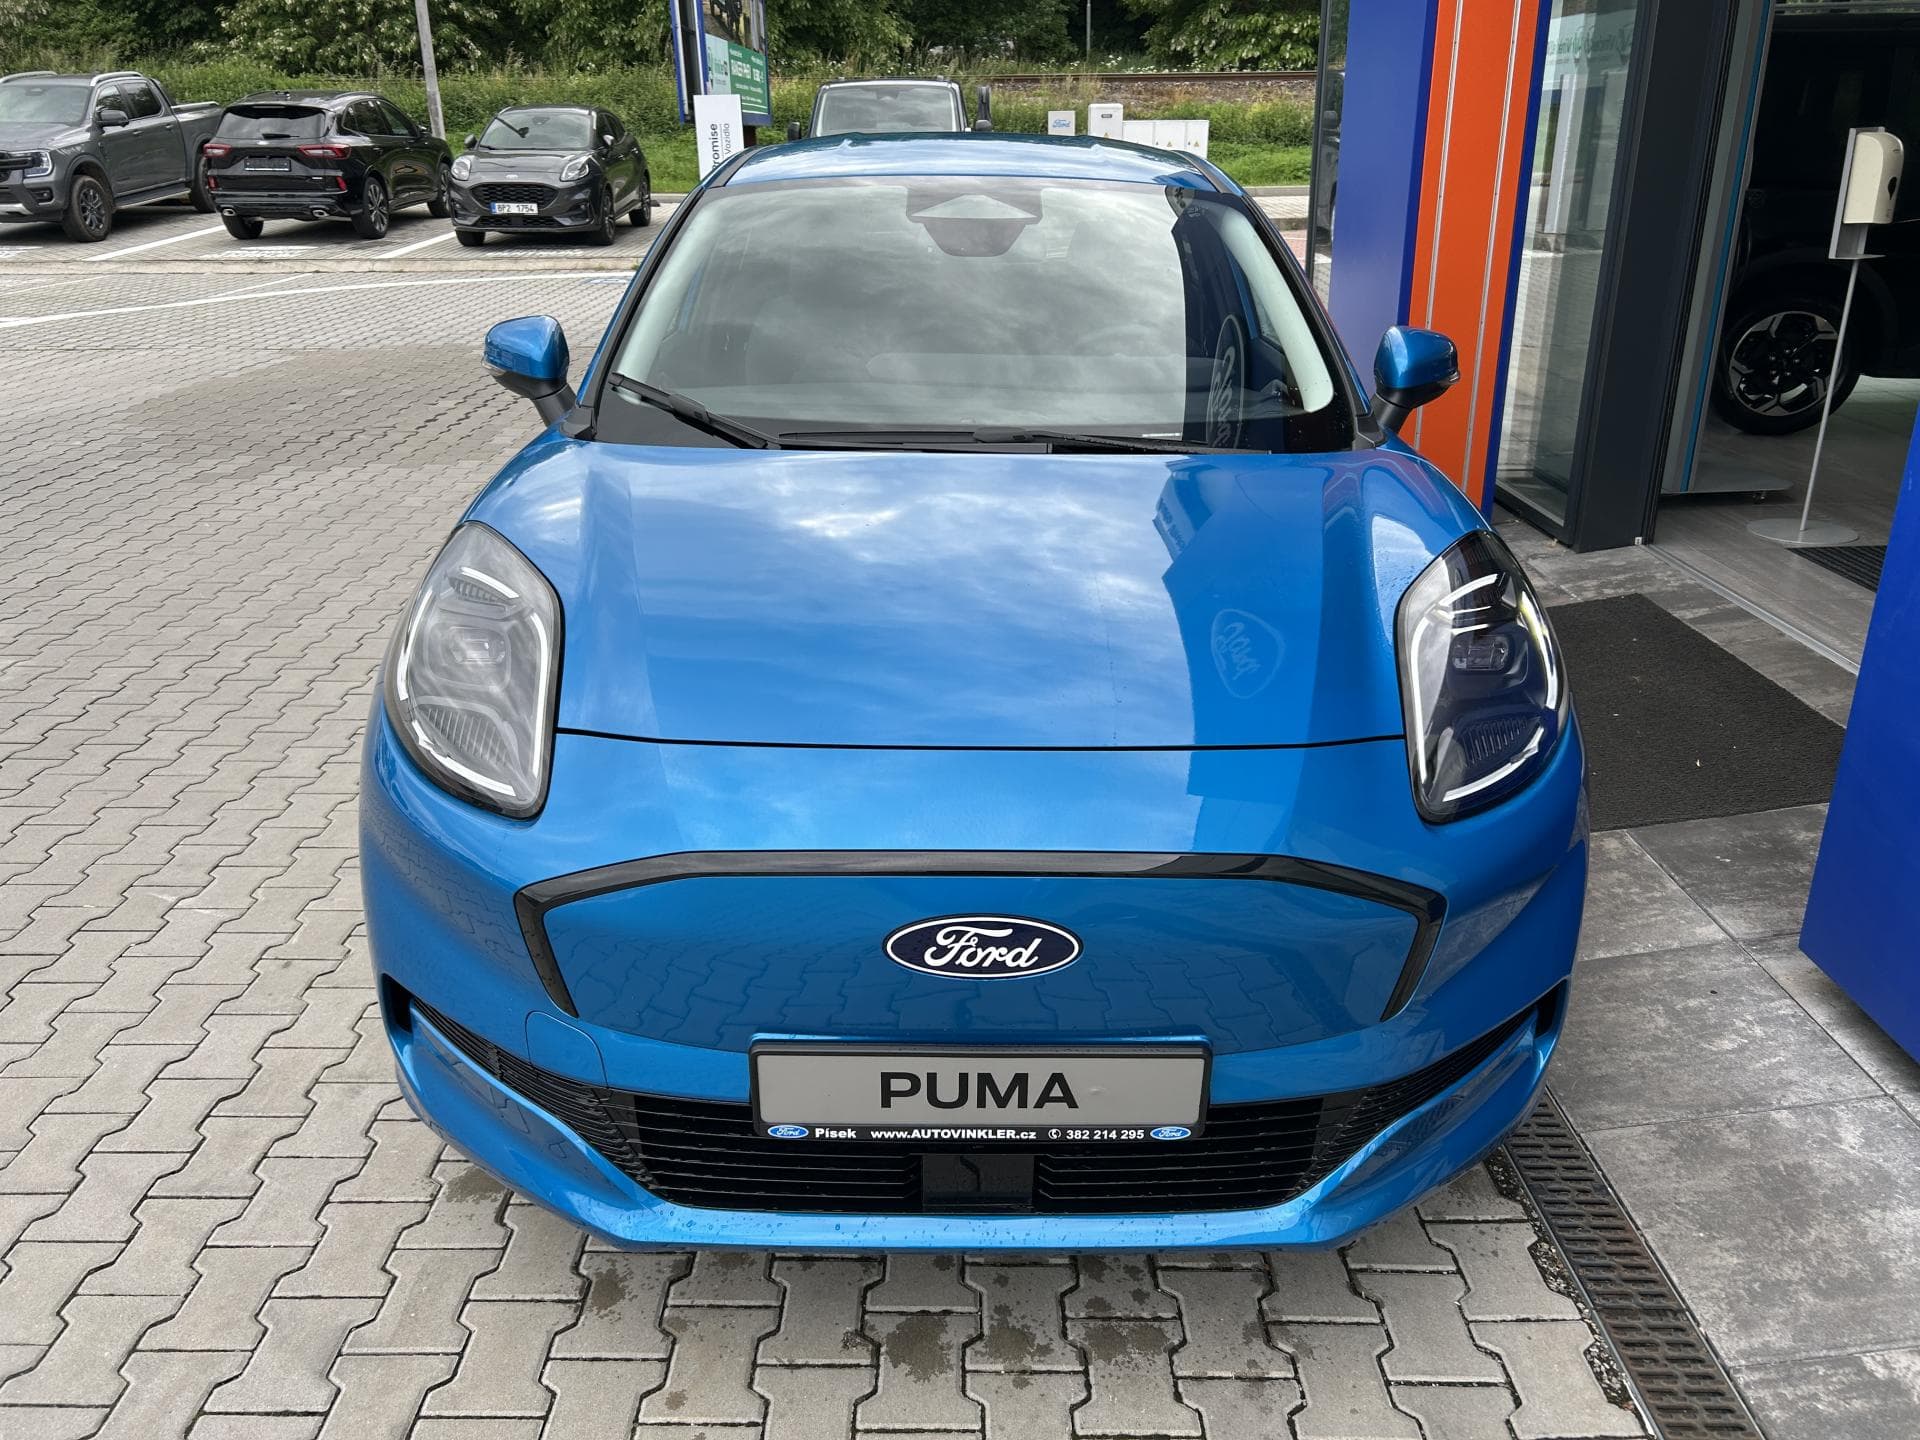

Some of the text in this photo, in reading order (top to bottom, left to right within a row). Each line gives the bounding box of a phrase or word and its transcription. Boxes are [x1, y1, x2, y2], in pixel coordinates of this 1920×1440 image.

[923, 925, 1043, 968] Ford
[880, 1071, 1079, 1109] PUMA
[776, 1127, 801, 1137] Ford
[815, 1128, 1145, 1140] Písek www.AUTOVINKLER.cz 382 214 295
[1158, 1128, 1182, 1138] Ford
